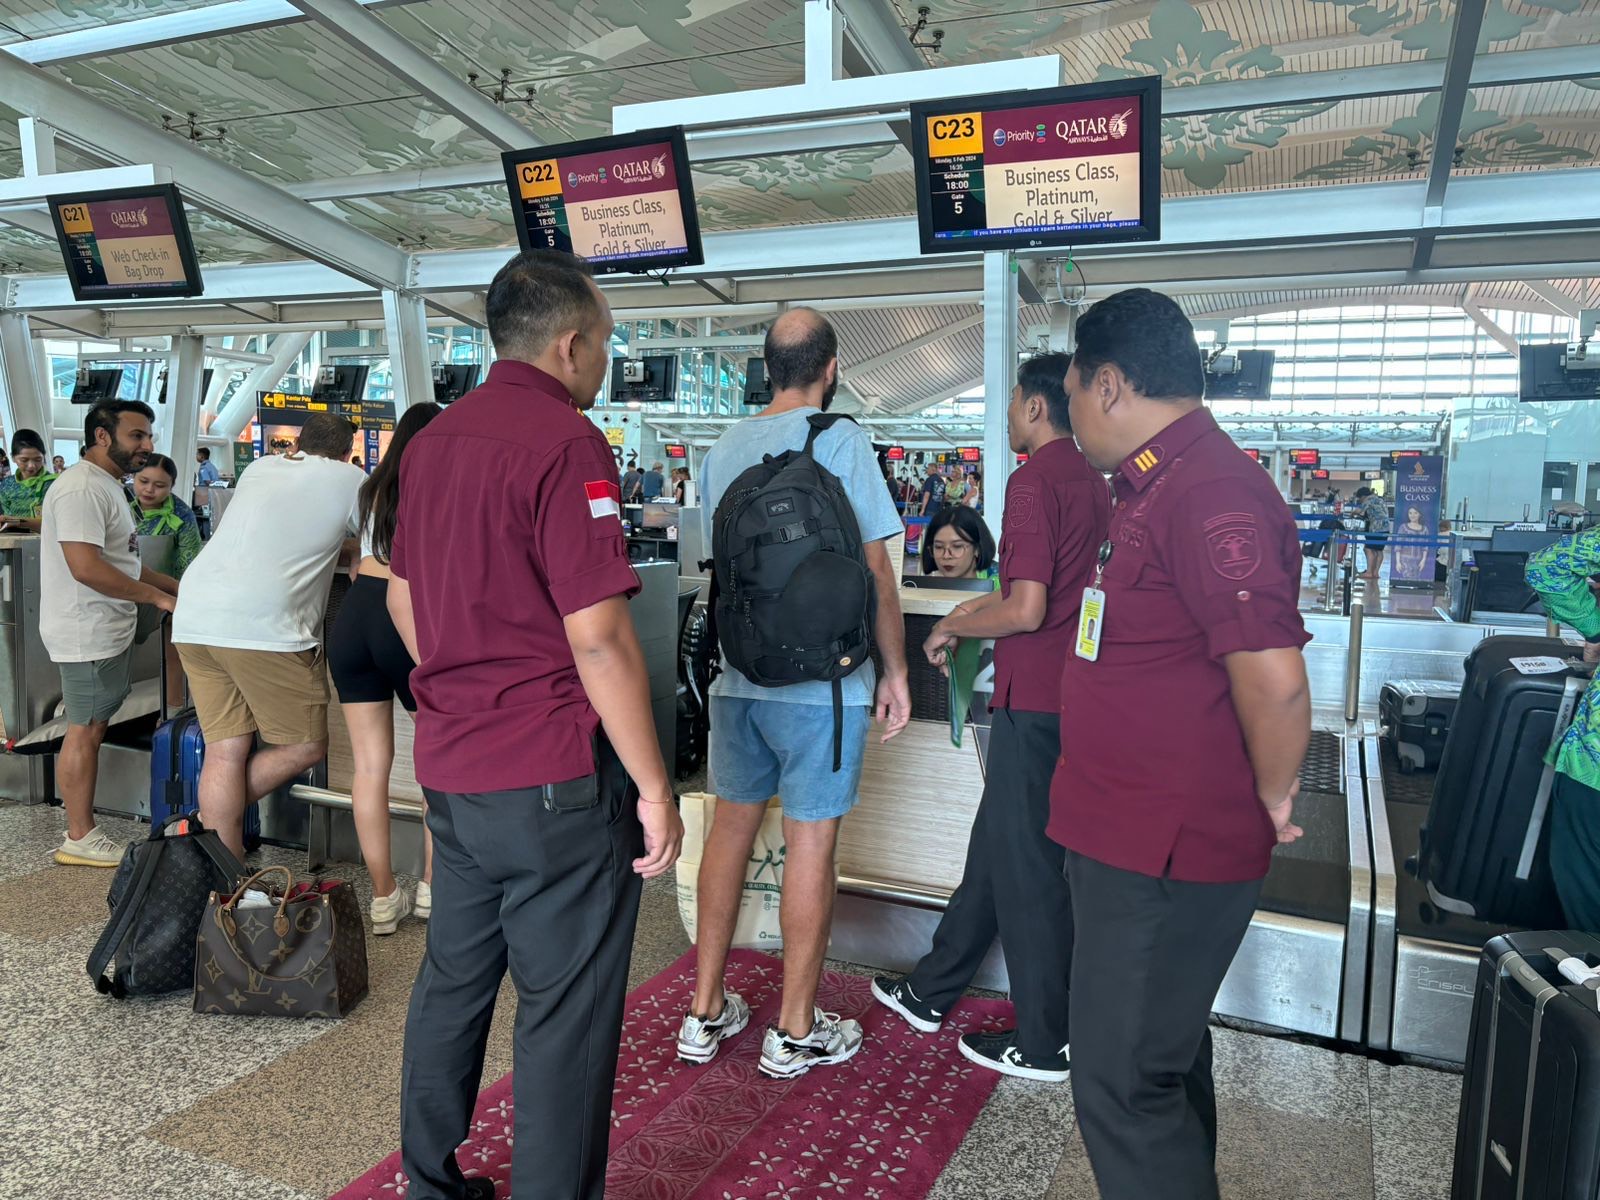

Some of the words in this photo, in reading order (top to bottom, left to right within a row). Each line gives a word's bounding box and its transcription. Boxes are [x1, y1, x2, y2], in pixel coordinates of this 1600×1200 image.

[933, 118, 975, 140] C23
[1007, 130, 1035, 142] Priority
[1056, 117, 1107, 140] QATAR
[522, 164, 554, 184] C22
[577, 172, 599, 183] Priority
[612, 160, 651, 181] QATAR
[1005, 167, 1070, 186] Business
[1075, 162, 1119, 182] Class,
[946, 181, 969, 190] 18:00
[1026, 188, 1099, 207] Platinum,
[63, 207, 85, 222] C21
[581, 203, 630, 221] Business
[633, 199, 666, 215] Class,
[954, 201, 963, 214] 5
[111, 211, 138, 225] QATAR
[539, 218, 556, 226] 18:00
[1013, 210, 1047, 229] Gold
[1054, 209, 1064, 225] &
[1070, 207, 1113, 224] Silver
[599, 222, 654, 239] Platinum,
[547, 236, 555, 247] 5
[593, 240, 619, 256] Gold
[622, 240, 631, 253] &
[635, 238, 666, 252] Silver
[111, 250, 130, 263] Web
[132, 248, 170, 262] Check-in
[86, 264, 93, 274] 5
[124, 265, 142, 280] Bag
[143, 263, 165, 278] Drop
[1400, 485, 1437, 493] BUSINESS
[1405, 493, 1430, 501] CLASS
